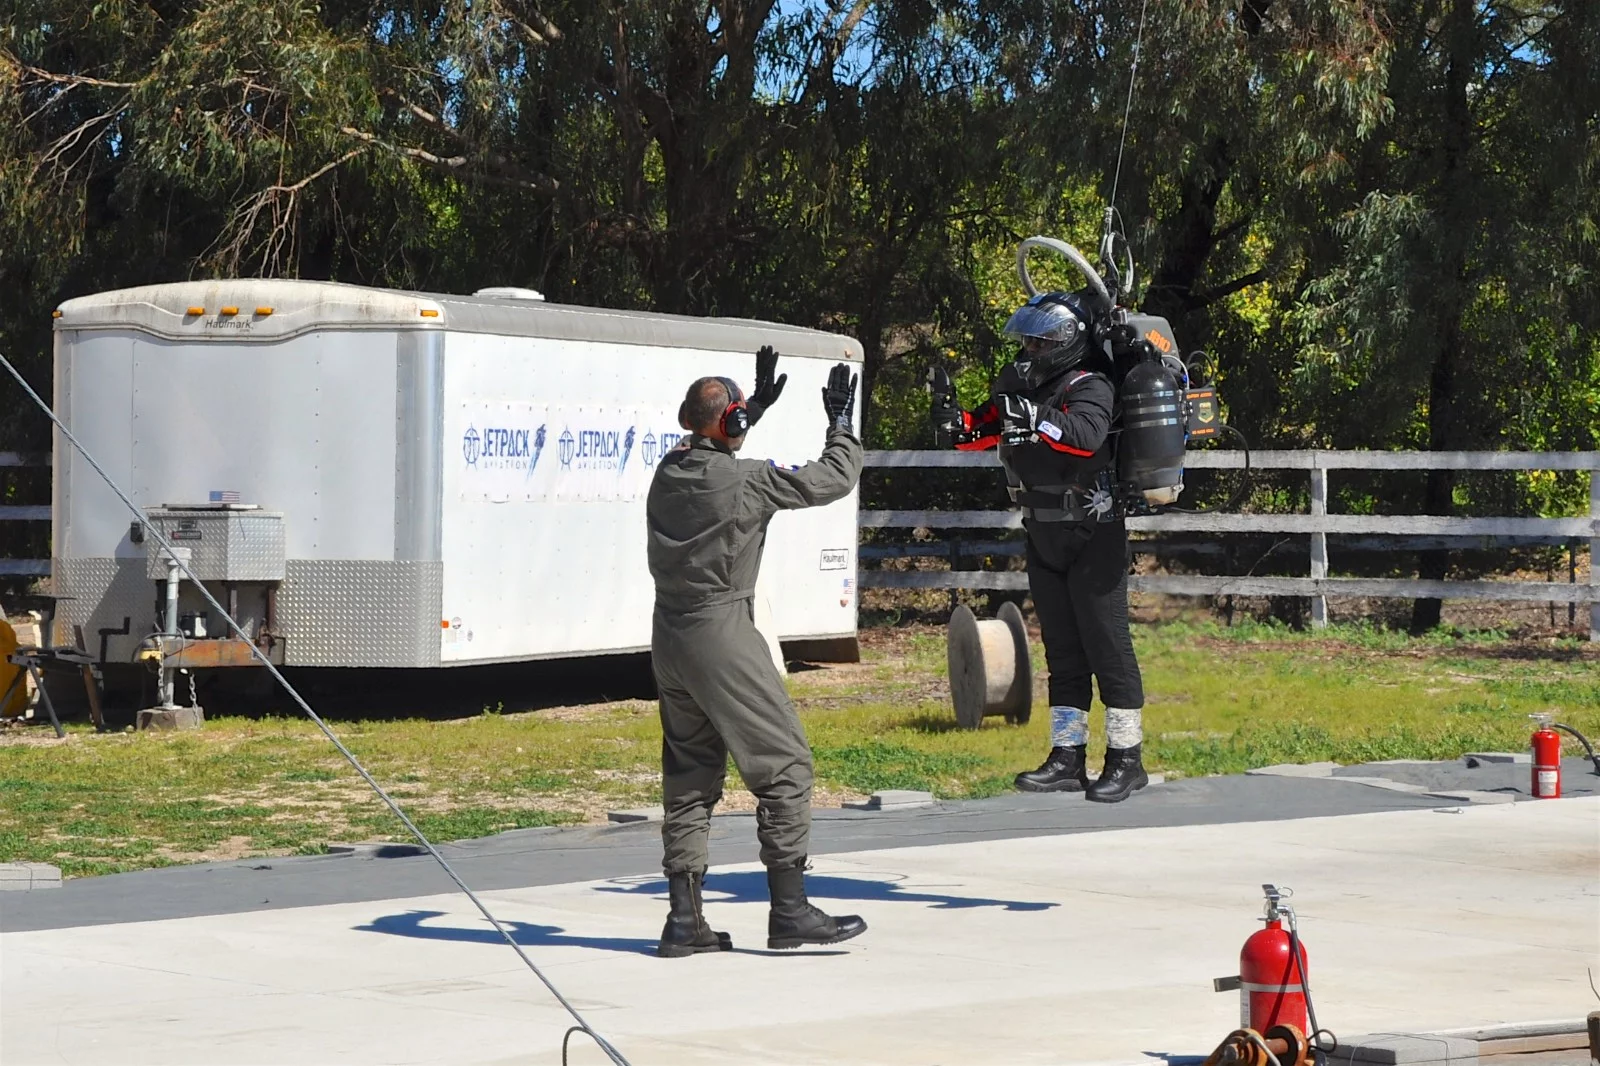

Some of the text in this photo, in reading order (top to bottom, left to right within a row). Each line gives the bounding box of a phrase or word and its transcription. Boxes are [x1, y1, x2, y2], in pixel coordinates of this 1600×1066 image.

[204, 318, 252, 329] Haulmark
[481, 428, 530, 457] JETPACK
[576, 430, 620, 458] JETPACK
[659, 433, 681, 458] JETP
